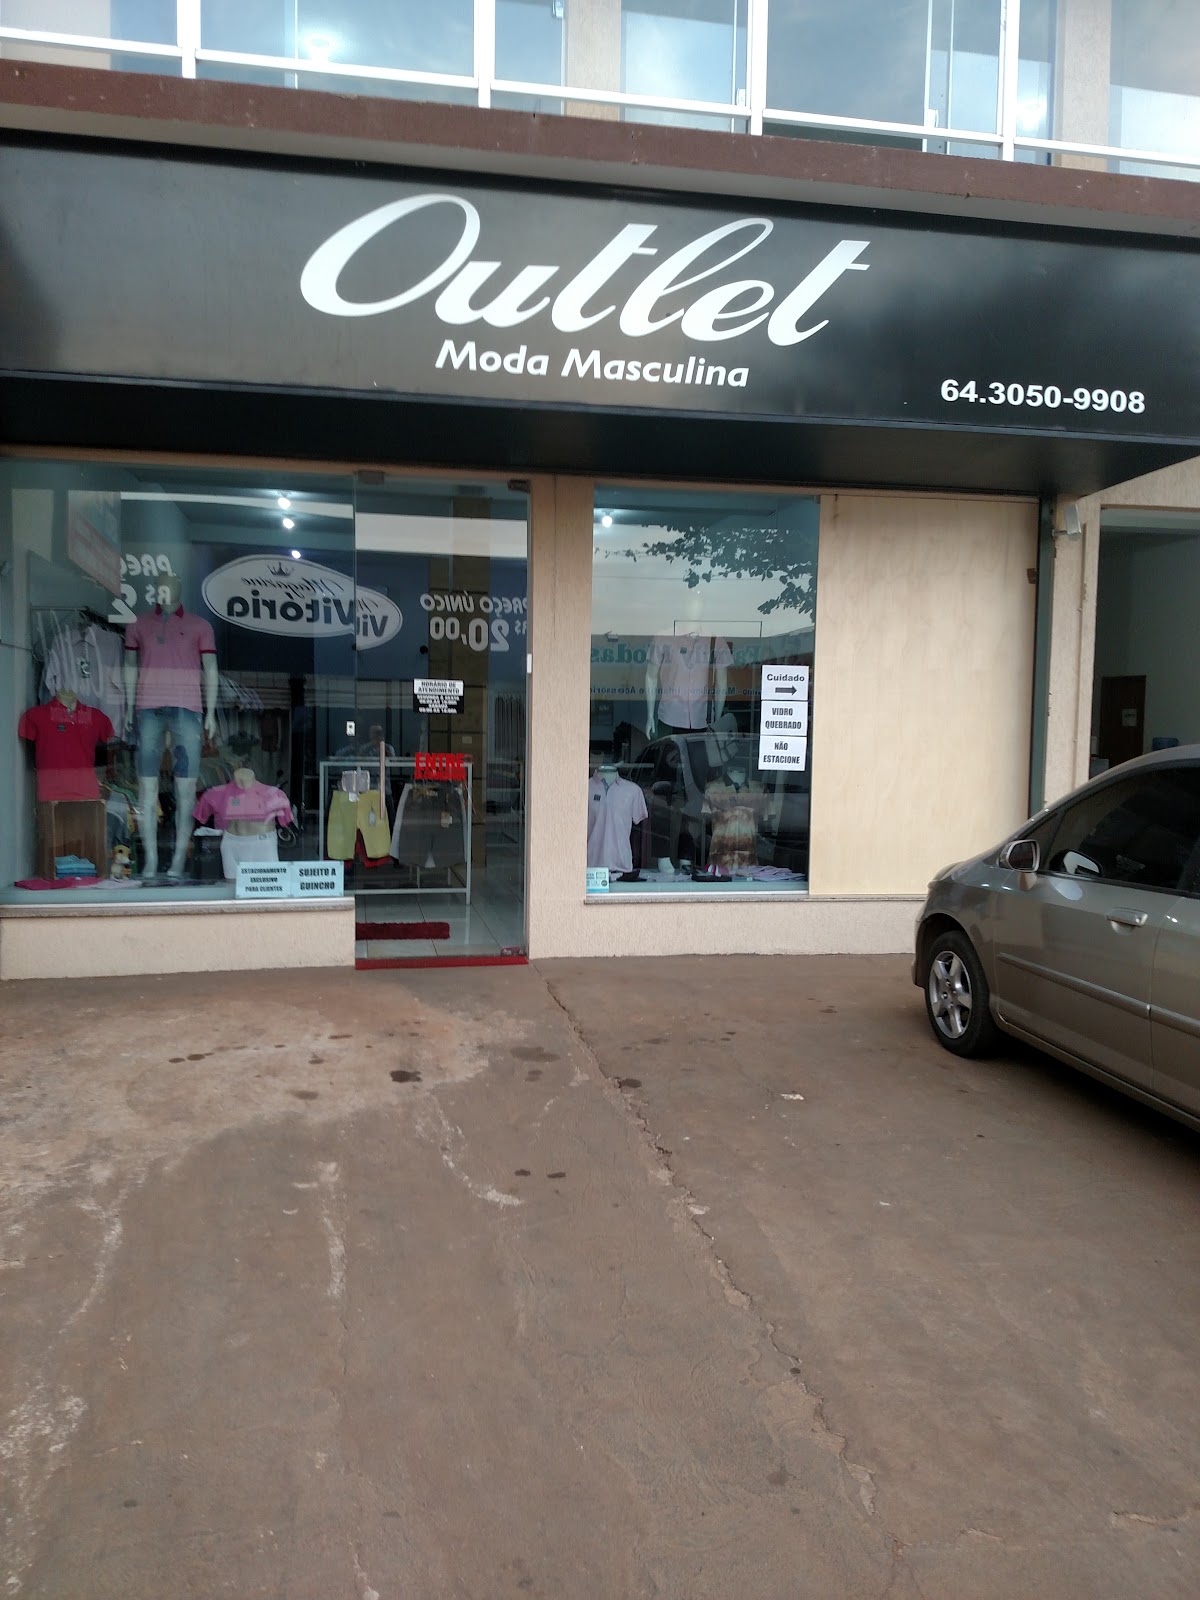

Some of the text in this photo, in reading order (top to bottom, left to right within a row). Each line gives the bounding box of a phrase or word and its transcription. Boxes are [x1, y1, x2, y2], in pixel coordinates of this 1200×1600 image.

[300, 193, 871, 347] Outlet
[435, 338, 750, 388] Moda Masculina
[940, 378, 1146, 414] 64.3050-9908
[766, 673, 805, 682] Cuidado
[772, 707, 794, 716] VIDRO
[765, 720, 802, 729] QUEBRADO
[774, 741, 789, 750] NÃO
[415, 752, 465, 771] ENTRE
[763, 754, 800, 764] ESTACIONE
[299, 868, 337, 876] SUJEITO A
[300, 881, 335, 891] GUINCHO
